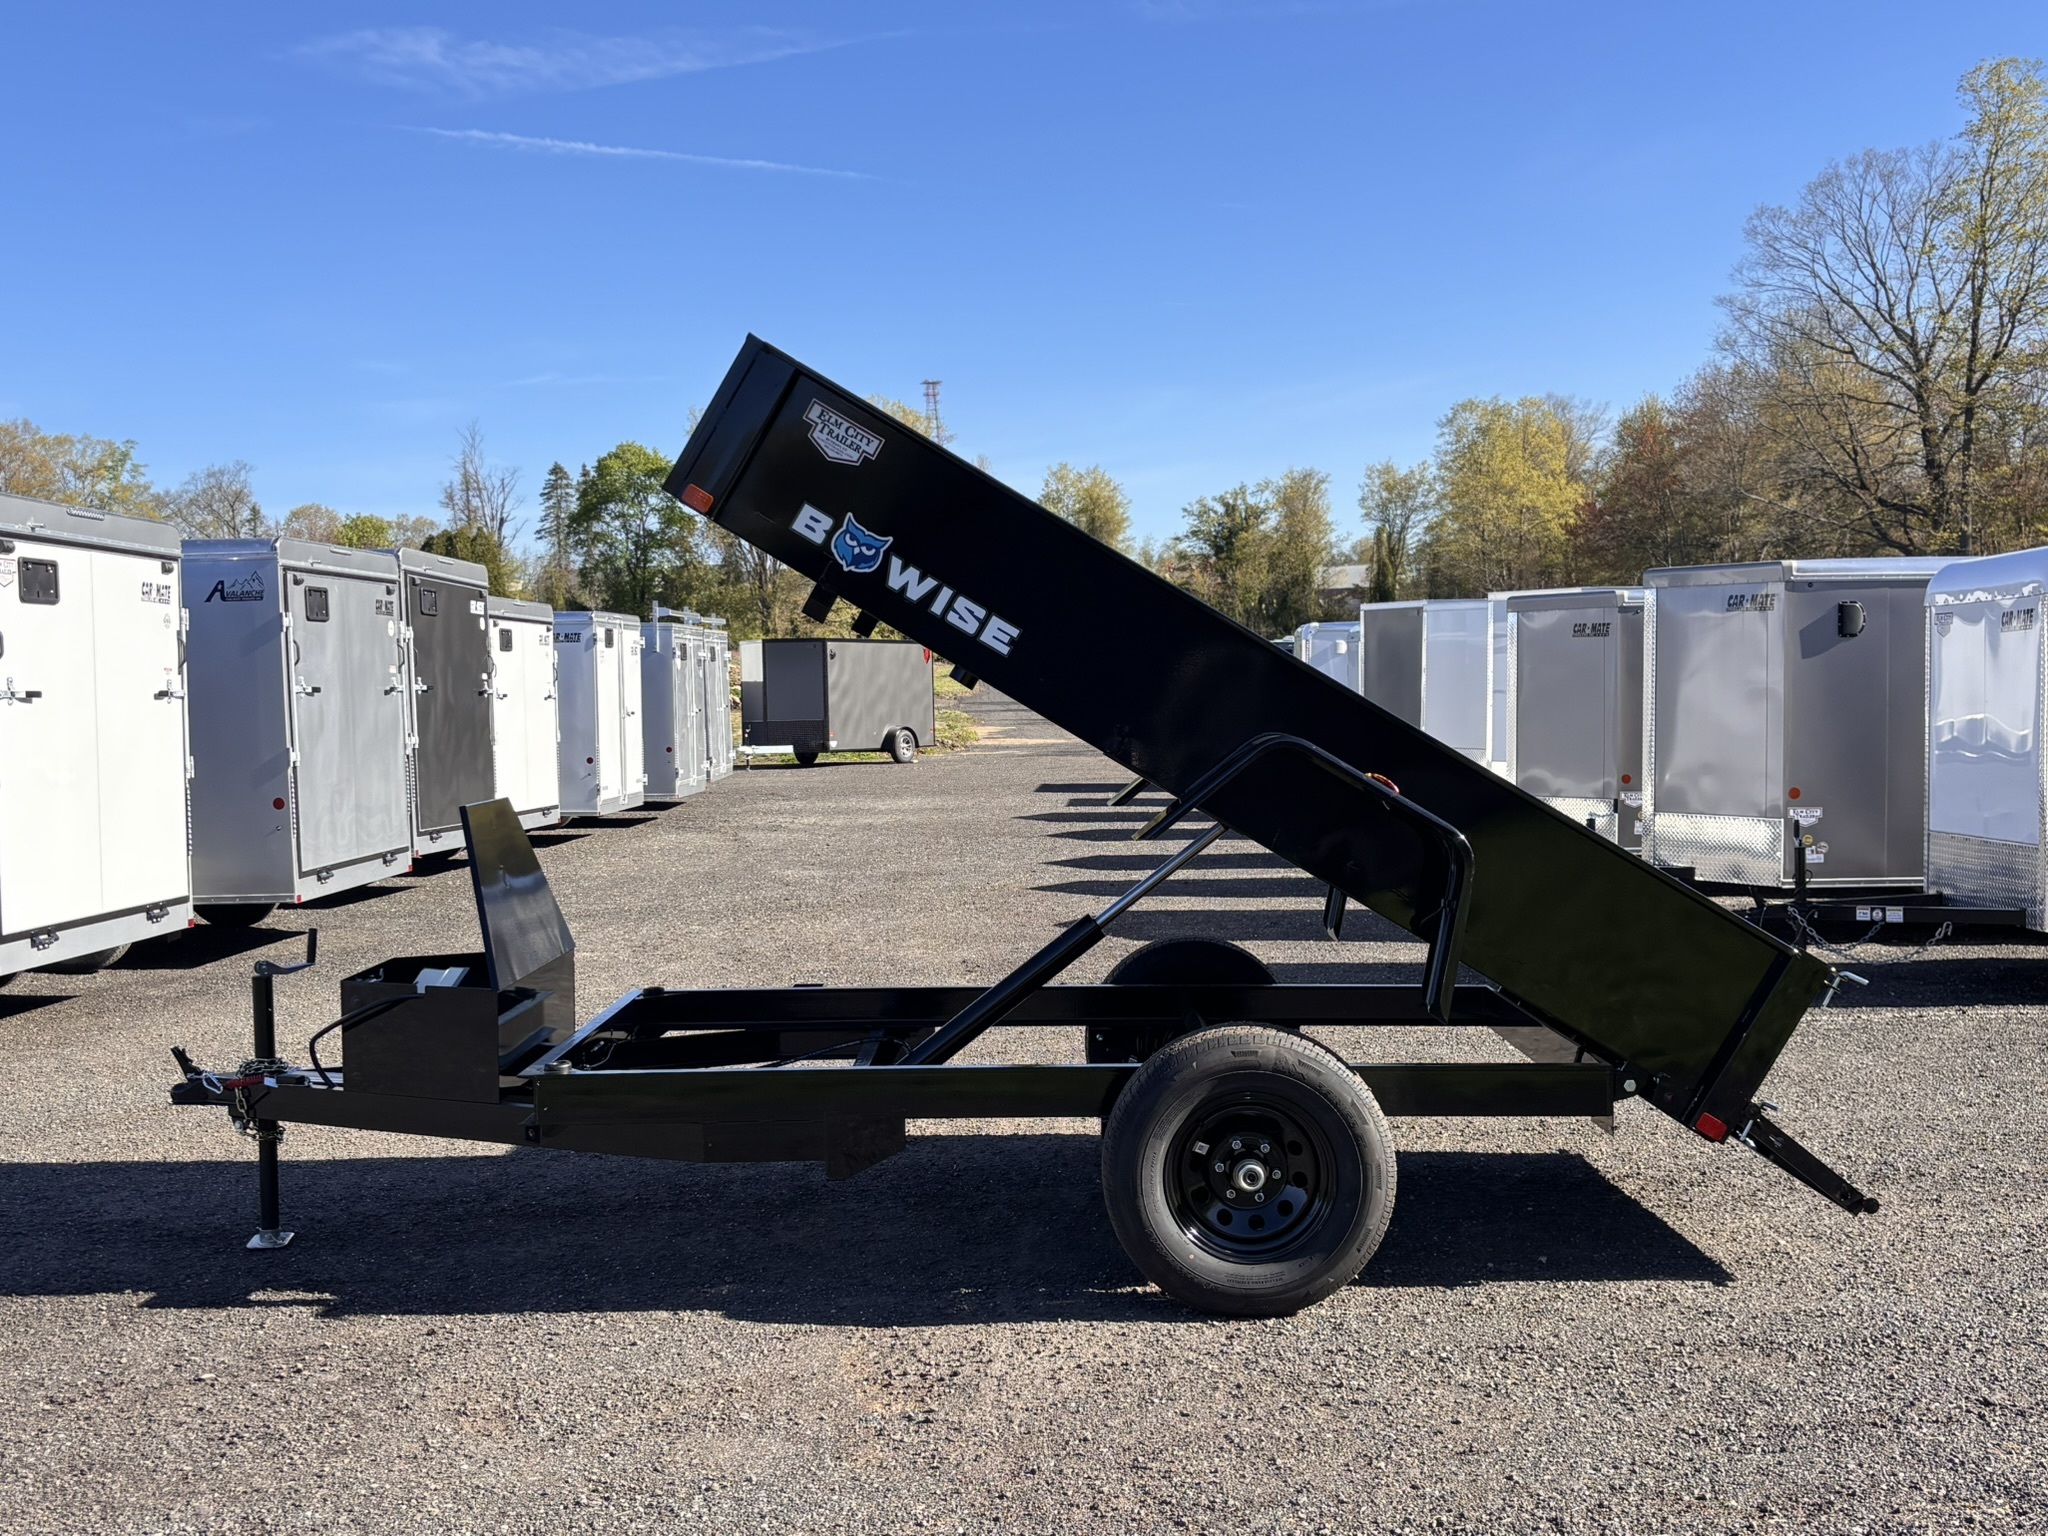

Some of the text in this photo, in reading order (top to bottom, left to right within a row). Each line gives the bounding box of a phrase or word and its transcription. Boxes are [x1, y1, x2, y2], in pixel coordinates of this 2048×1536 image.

[816, 409, 875, 447] ELM CITY
[818, 421, 862, 454] TRAILER
[204, 579, 265, 602] AVALANCHE
